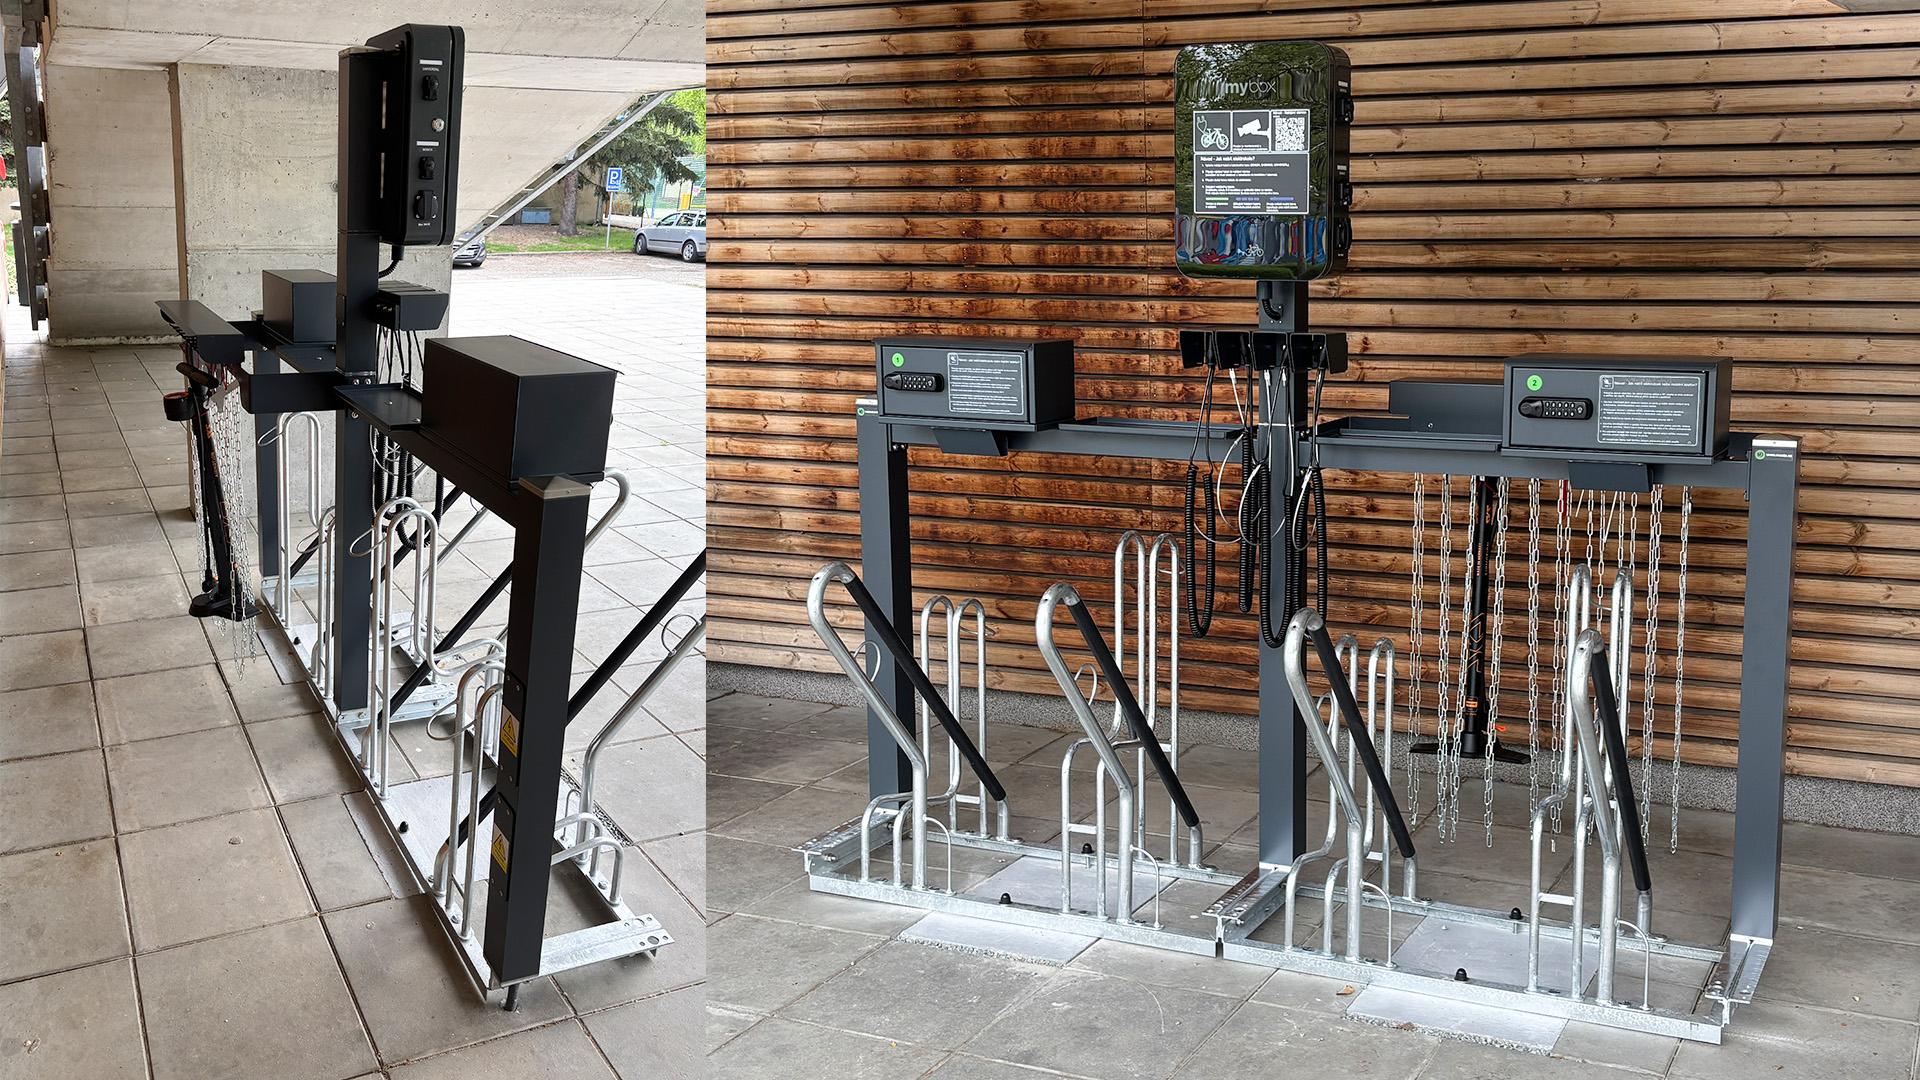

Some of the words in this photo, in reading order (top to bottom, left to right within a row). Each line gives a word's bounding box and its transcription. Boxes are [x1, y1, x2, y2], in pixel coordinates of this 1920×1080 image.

[1225, 80, 1276, 97] mybox
[610, 171, 619, 185] P
[1532, 379, 1538, 387] 2
